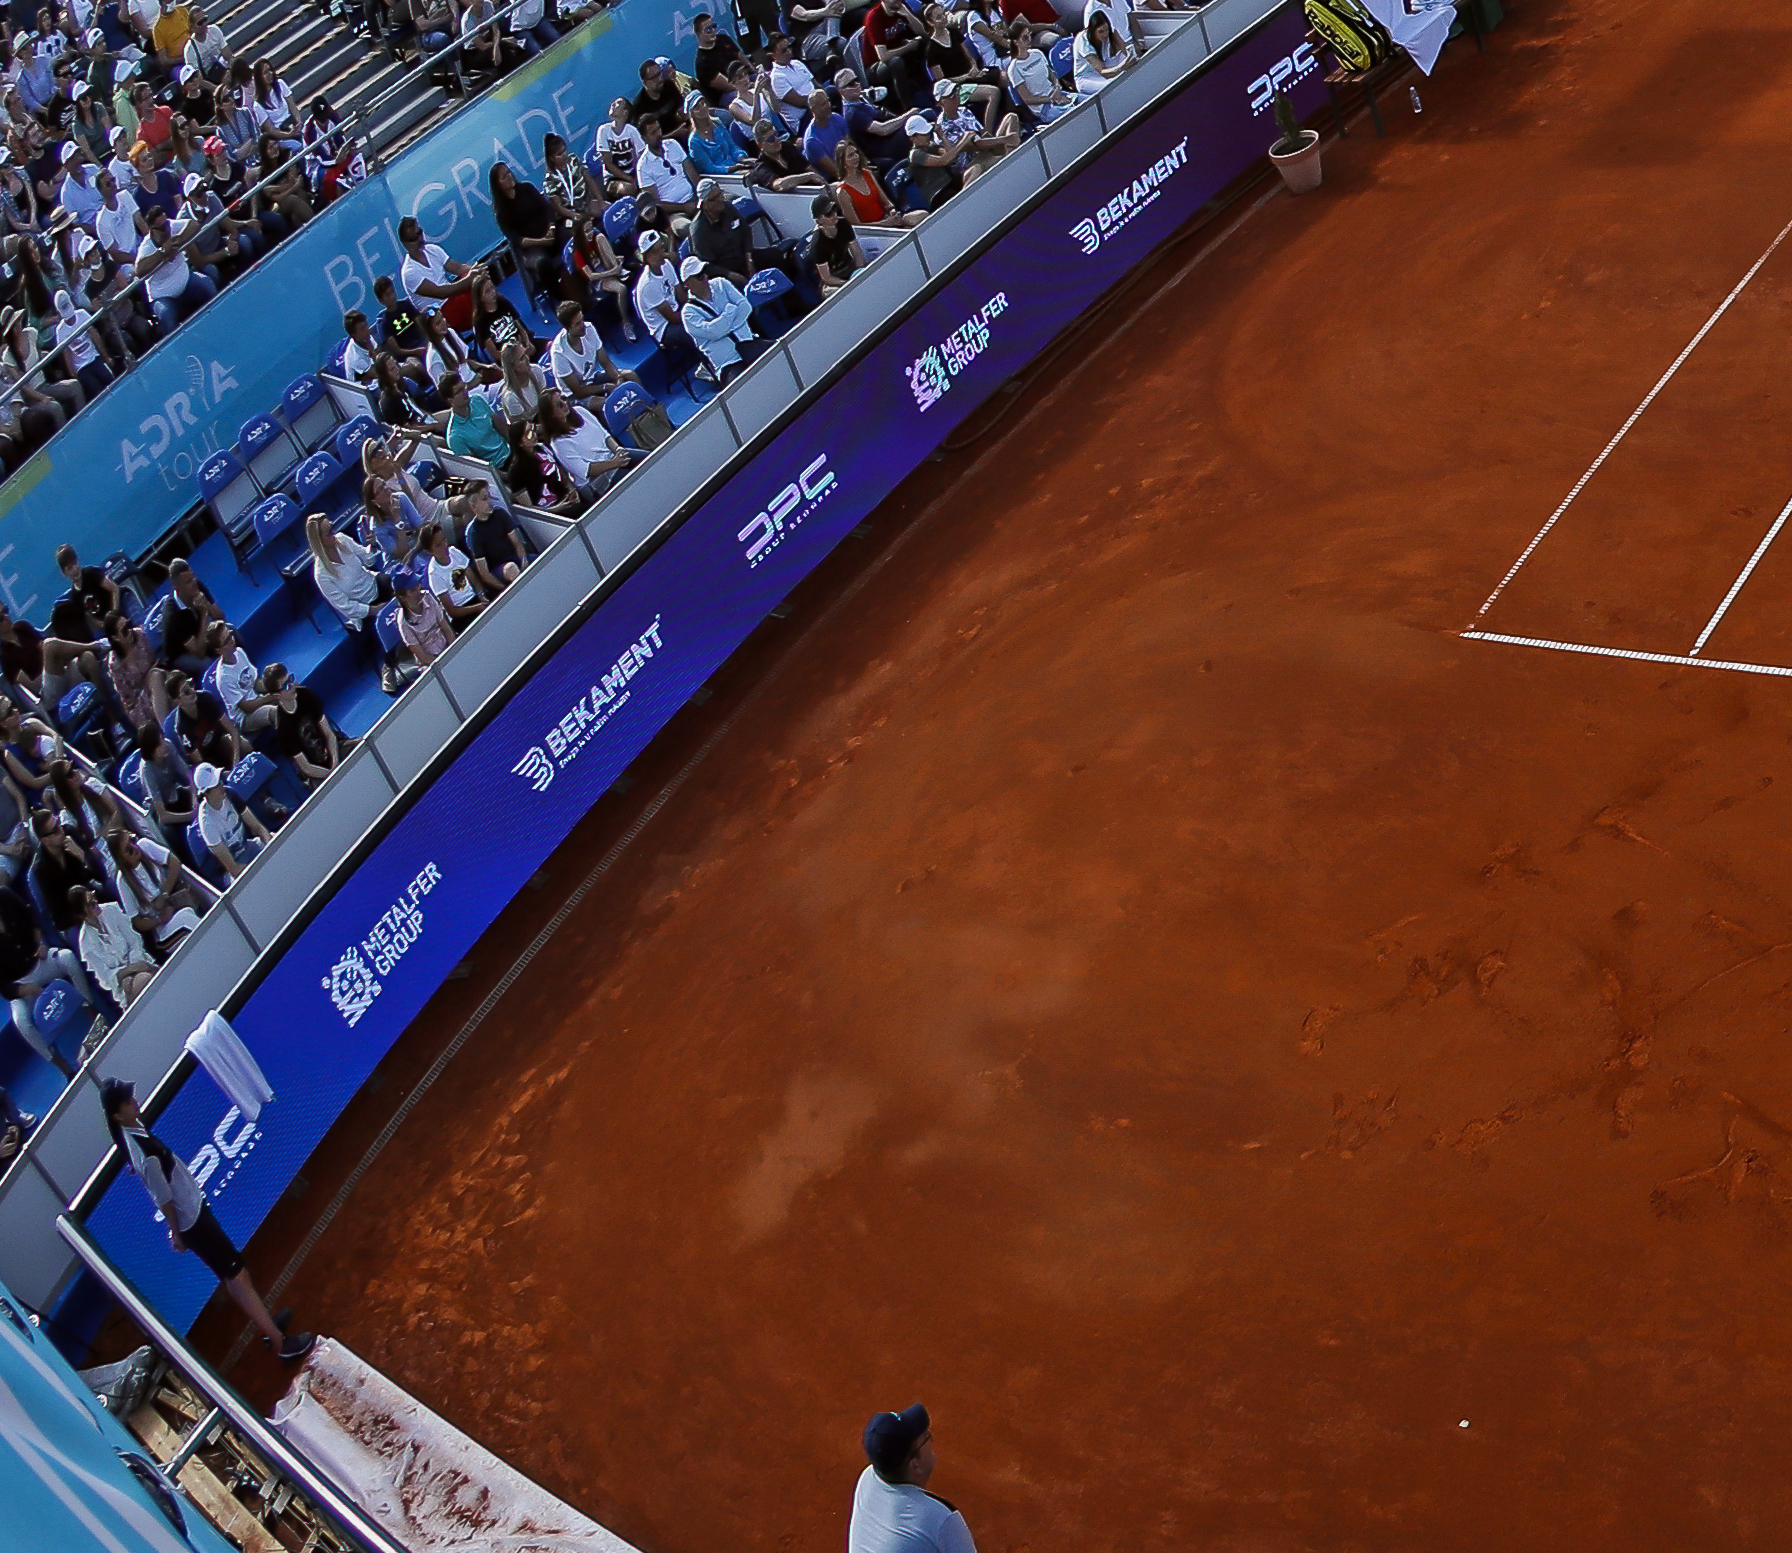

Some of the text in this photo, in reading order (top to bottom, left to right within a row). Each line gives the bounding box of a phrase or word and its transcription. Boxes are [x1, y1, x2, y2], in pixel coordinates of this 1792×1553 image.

[1096, 138, 1189, 232] BEKAMENT
[940, 291, 1010, 361] METALFER
[947, 327, 990, 377] GROUP
[113, 353, 240, 485] ADRIA
[544, 614, 664, 759] BEKAMENT
[361, 860, 443, 962] METALFER
[373, 909, 425, 977] GROUP
